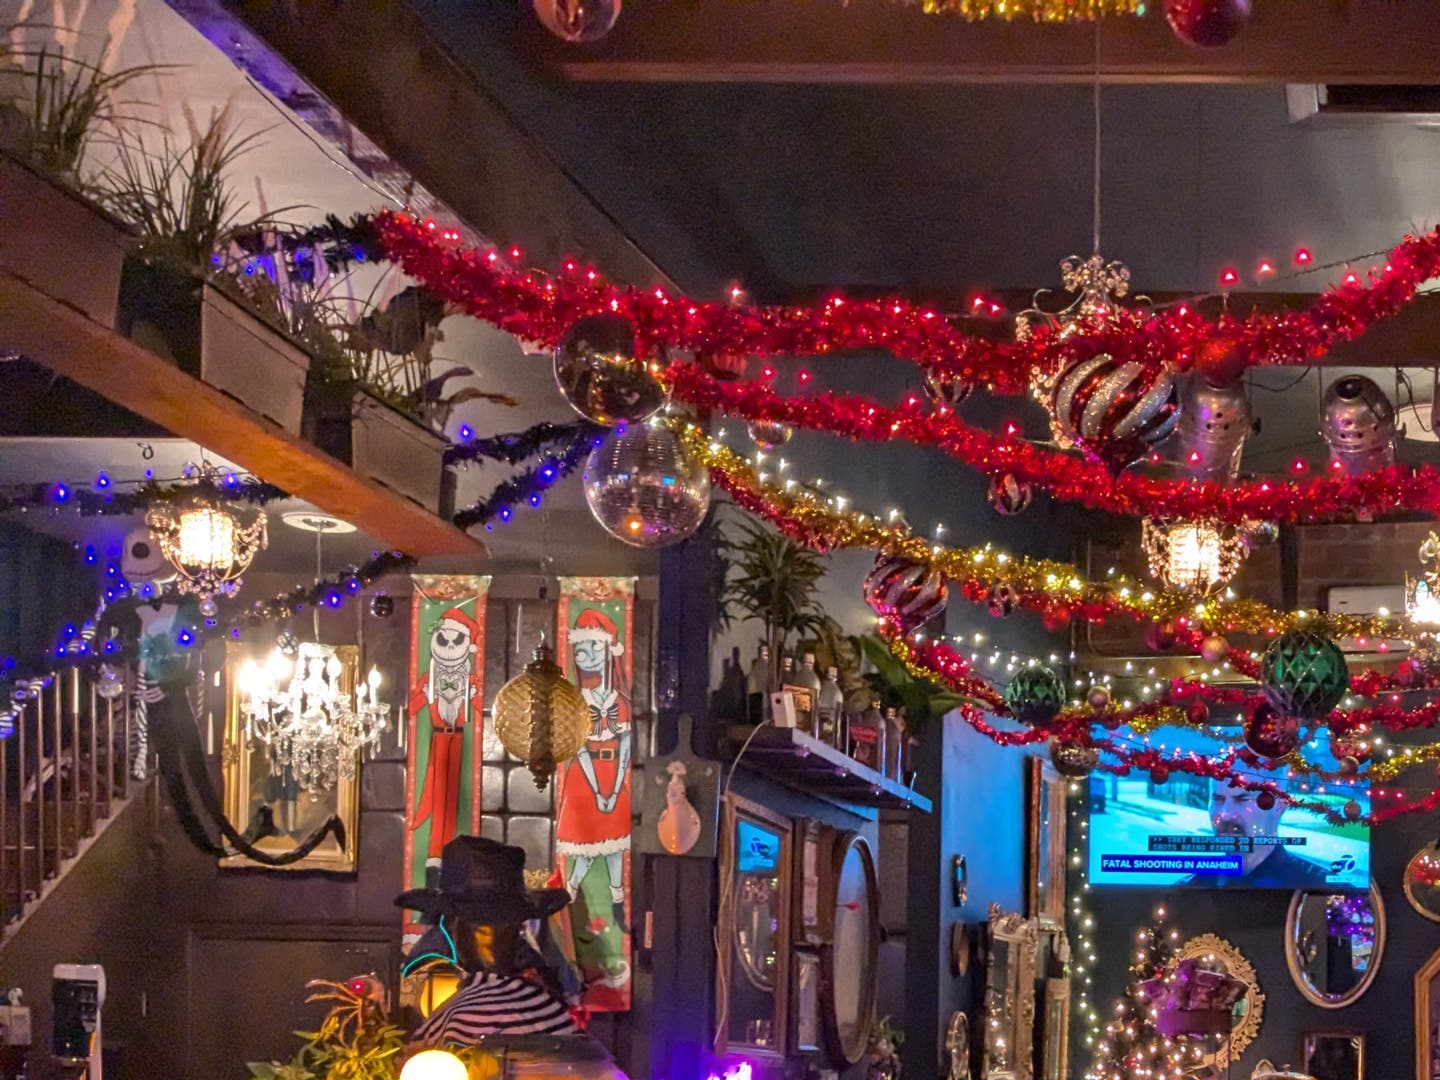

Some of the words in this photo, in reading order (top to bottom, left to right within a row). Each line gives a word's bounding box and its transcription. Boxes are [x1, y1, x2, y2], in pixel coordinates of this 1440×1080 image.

[1191, 836, 1236, 845] RESPONDED
[1102, 859, 1132, 868] FATAL
[1133, 860, 1183, 869] SHOOTING
[1184, 860, 1195, 869] IN
[1196, 861, 1239, 870] ANAHEIM
